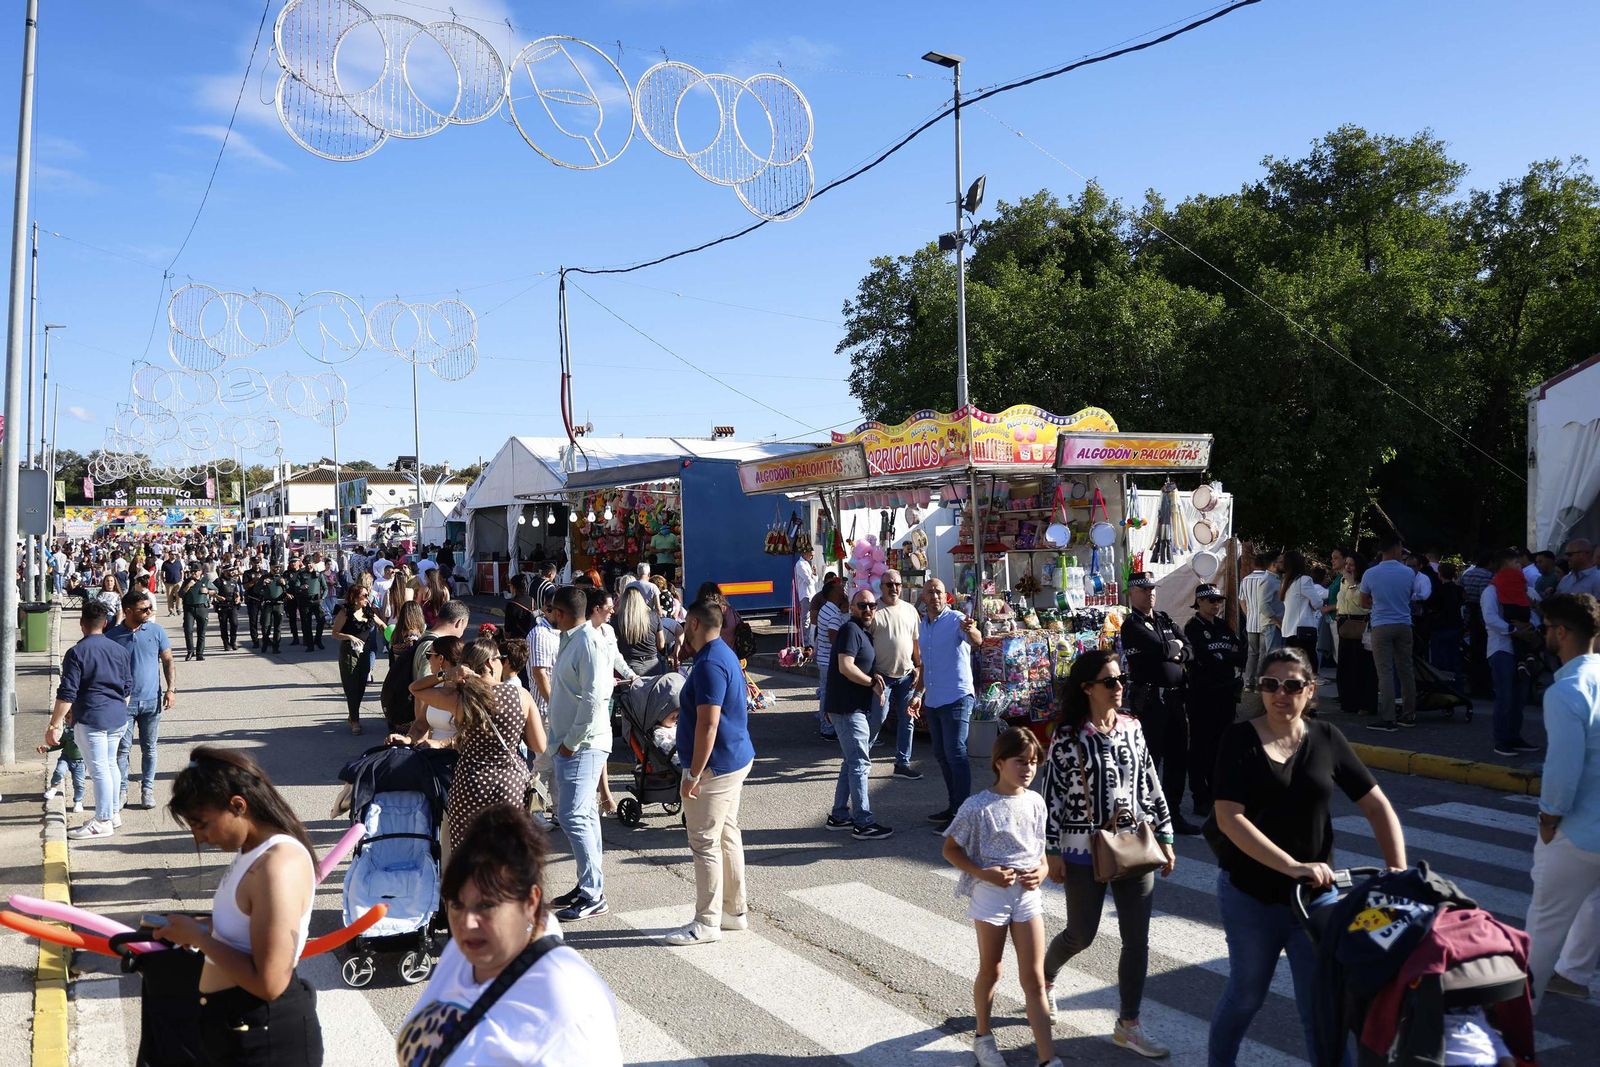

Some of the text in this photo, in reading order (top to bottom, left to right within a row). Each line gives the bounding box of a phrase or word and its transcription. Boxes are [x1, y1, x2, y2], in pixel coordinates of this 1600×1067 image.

[868, 439, 940, 475] APRICHITOS
[1077, 444, 1131, 459] ALGODÓN
[1139, 447, 1200, 460] PALOMITAS
[796, 459, 843, 477] PALOMITAS
[115, 486, 191, 499] EL AUTENTICO
